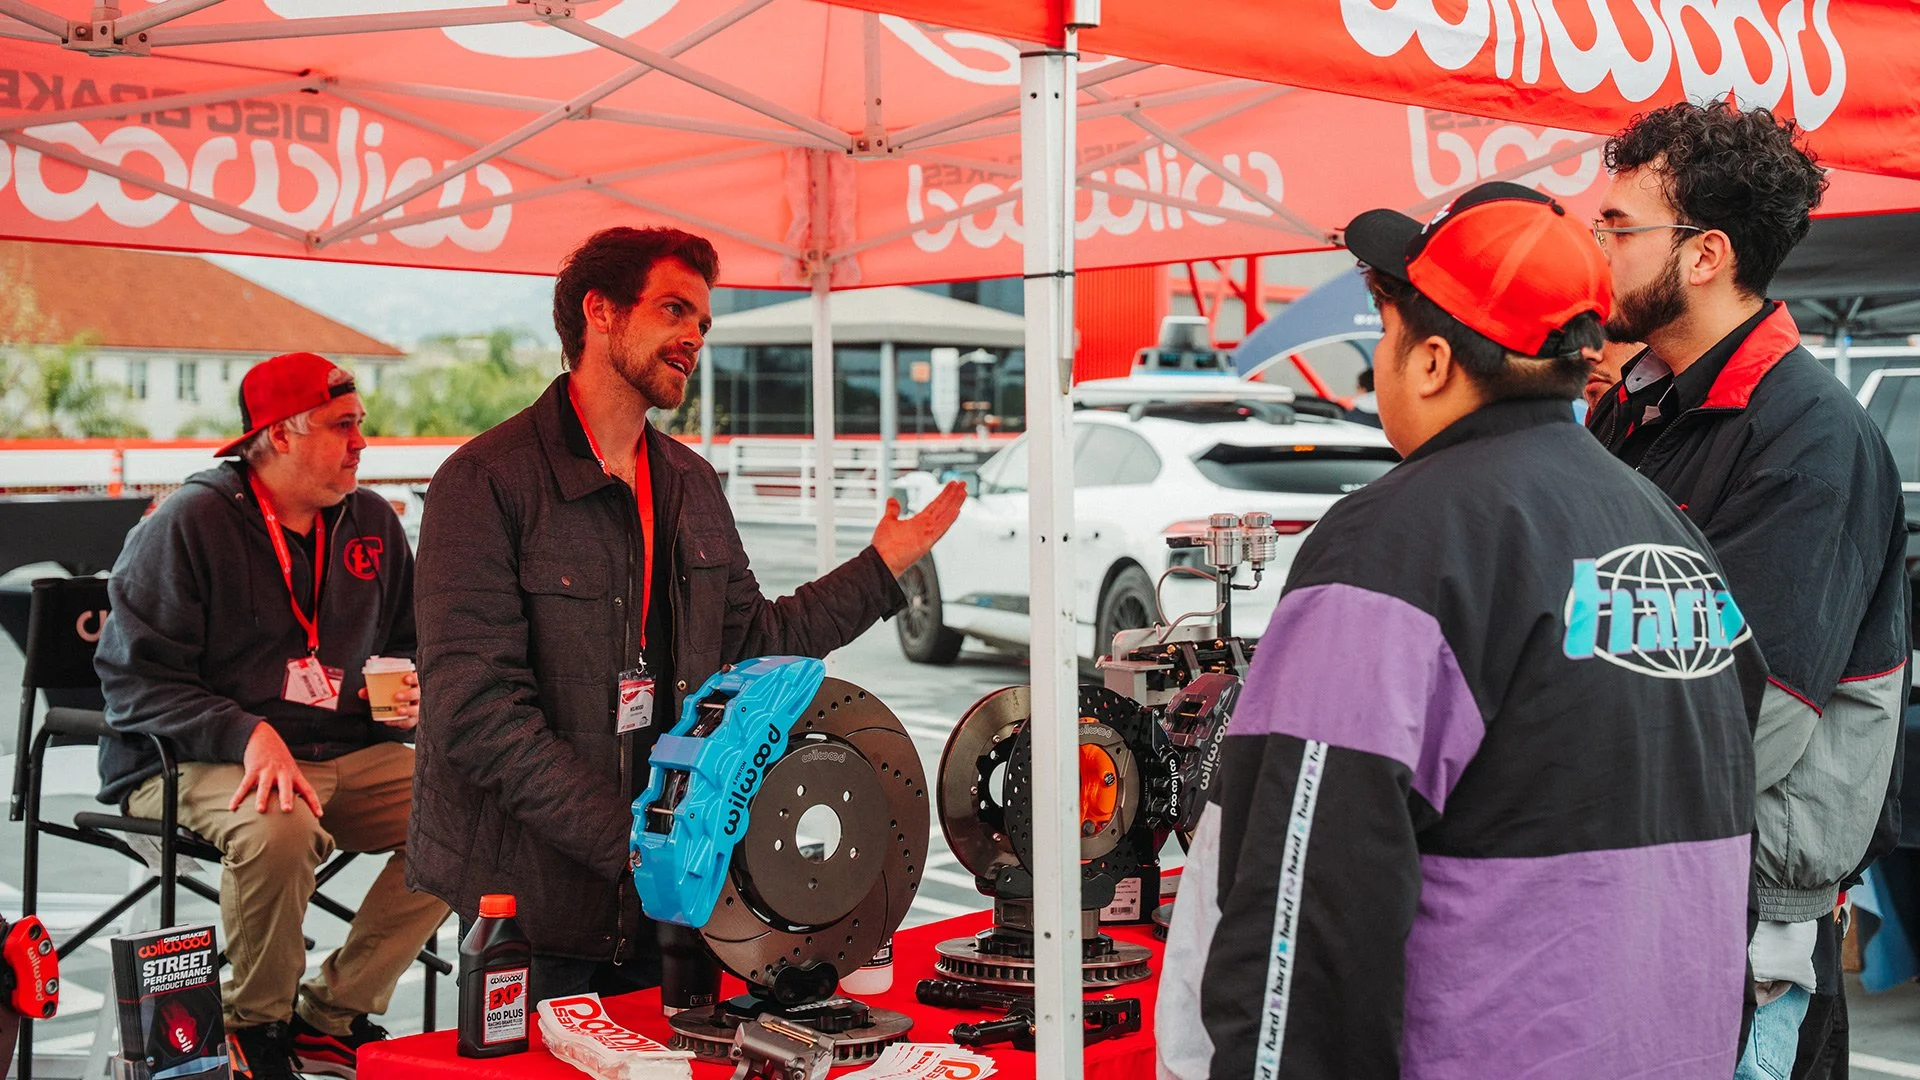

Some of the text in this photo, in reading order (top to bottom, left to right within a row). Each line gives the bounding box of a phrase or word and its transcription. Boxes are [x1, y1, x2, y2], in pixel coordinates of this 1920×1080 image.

[801, 748, 847, 764] wilwood
[1200, 711, 1232, 791] wilwood
[723, 722, 782, 836] wilwood
[1169, 758, 1180, 817] wilwood
[1287, 834, 1302, 876] hard
[138, 929, 212, 959] wilwood
[27, 947, 45, 1001] wilwood
[143, 949, 212, 978] STREET
[143, 965, 213, 987] PERFORMANCE
[490, 972, 524, 985] wilwood
[1271, 955, 1288, 996] hard
[150, 976, 208, 993] PRODUCT GUIDE
[488, 982, 523, 1011] EXP
[486, 1008, 524, 1022] 600 PLUS
[1264, 1011, 1280, 1051] hard
